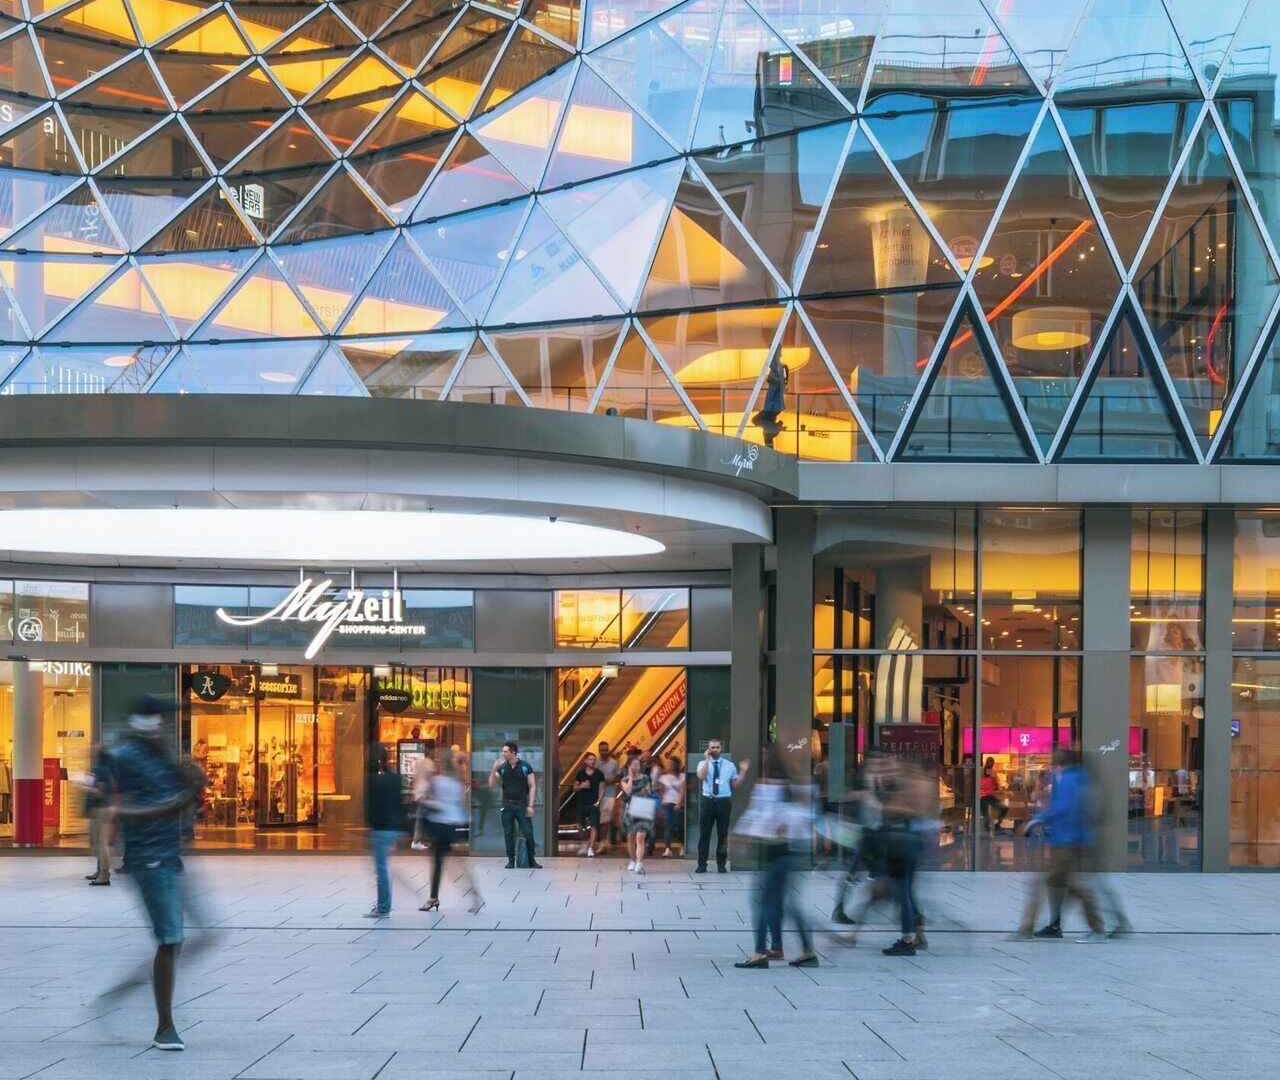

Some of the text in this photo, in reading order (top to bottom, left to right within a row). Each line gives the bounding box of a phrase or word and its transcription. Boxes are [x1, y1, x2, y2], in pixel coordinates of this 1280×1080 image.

[216, 578, 403, 660] MyZeil
[339, 625, 426, 635] SHOPPING-CENTER
[651, 694, 680, 730] FASHION
[45, 779, 54, 807] SALE
